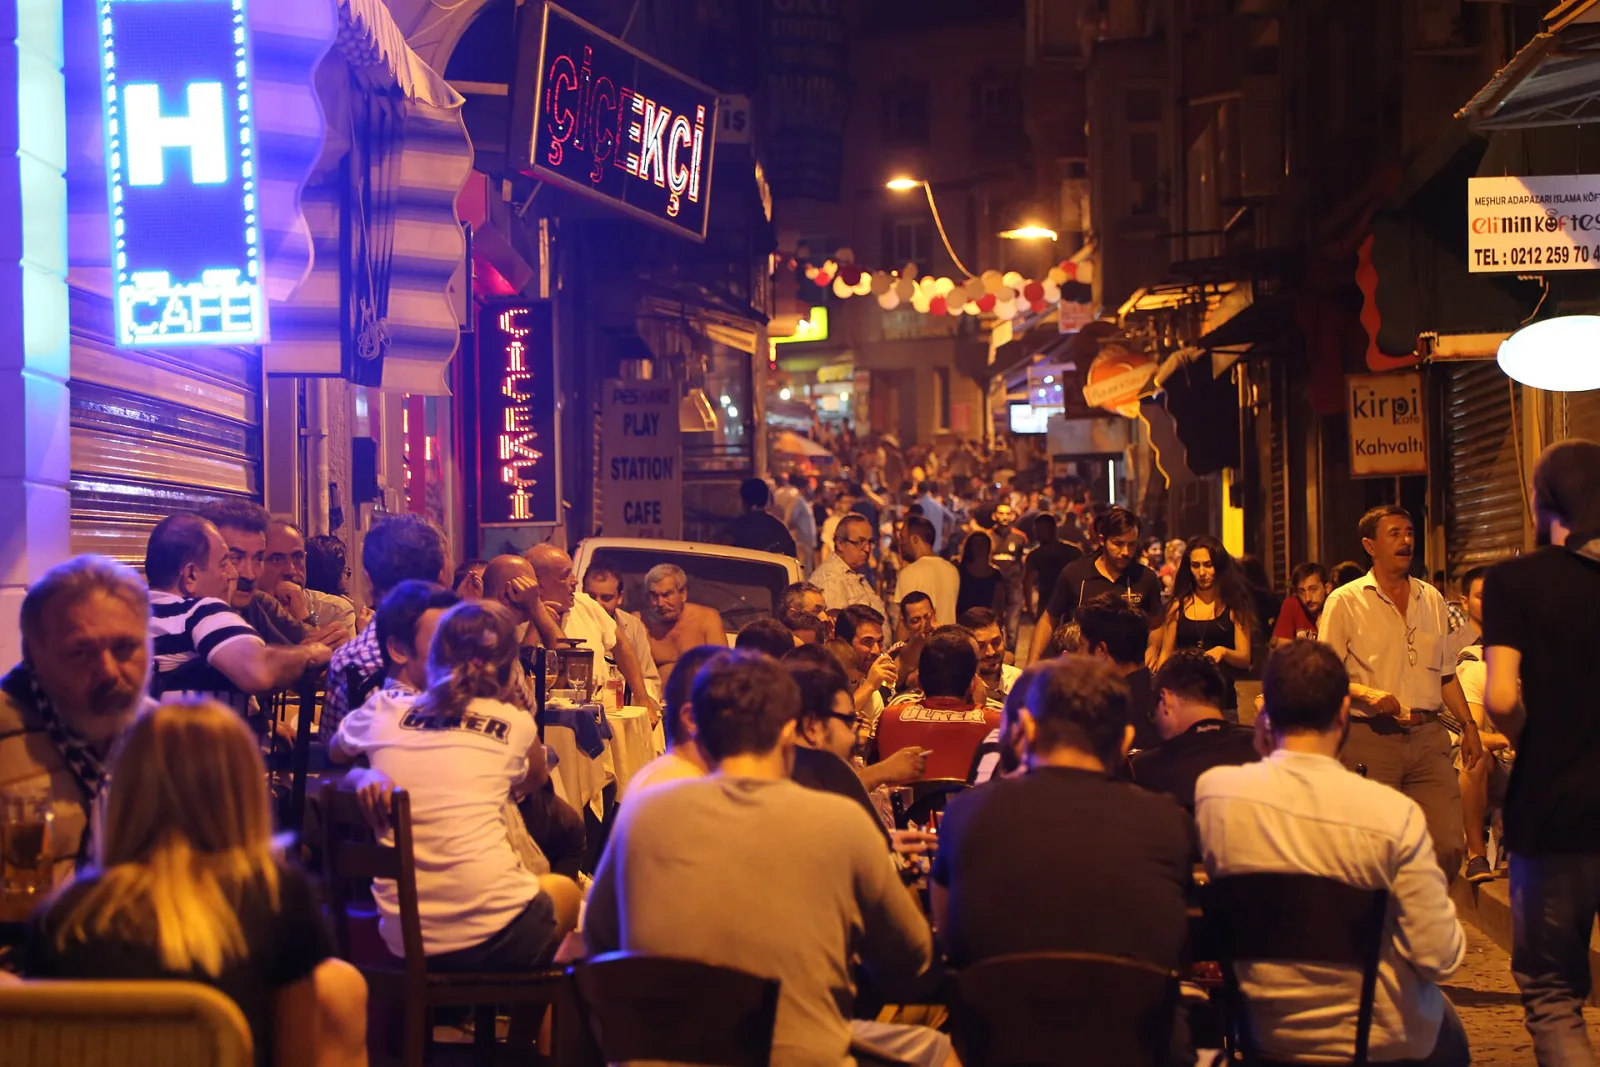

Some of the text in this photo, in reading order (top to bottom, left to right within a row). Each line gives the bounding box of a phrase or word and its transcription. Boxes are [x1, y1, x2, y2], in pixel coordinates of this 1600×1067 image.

[123, 82, 228, 186] H
[1474, 196, 1506, 207] MEŞHUR
[1508, 194, 1551, 204] ADAPAZARI
[1474, 249, 1499, 266] TEL
[1511, 247, 1542, 265] 0212
[1546, 246, 1569, 264] 259
[1574, 245, 1589, 263] 70
[121, 285, 252, 334] CAFE
[1353, 388, 1418, 425] kirpi
[623, 412, 660, 437] PLAY
[611, 456, 674, 481] STATION
[624, 501, 662, 525] CAFE
[900, 705, 984, 723] ÜLKER
